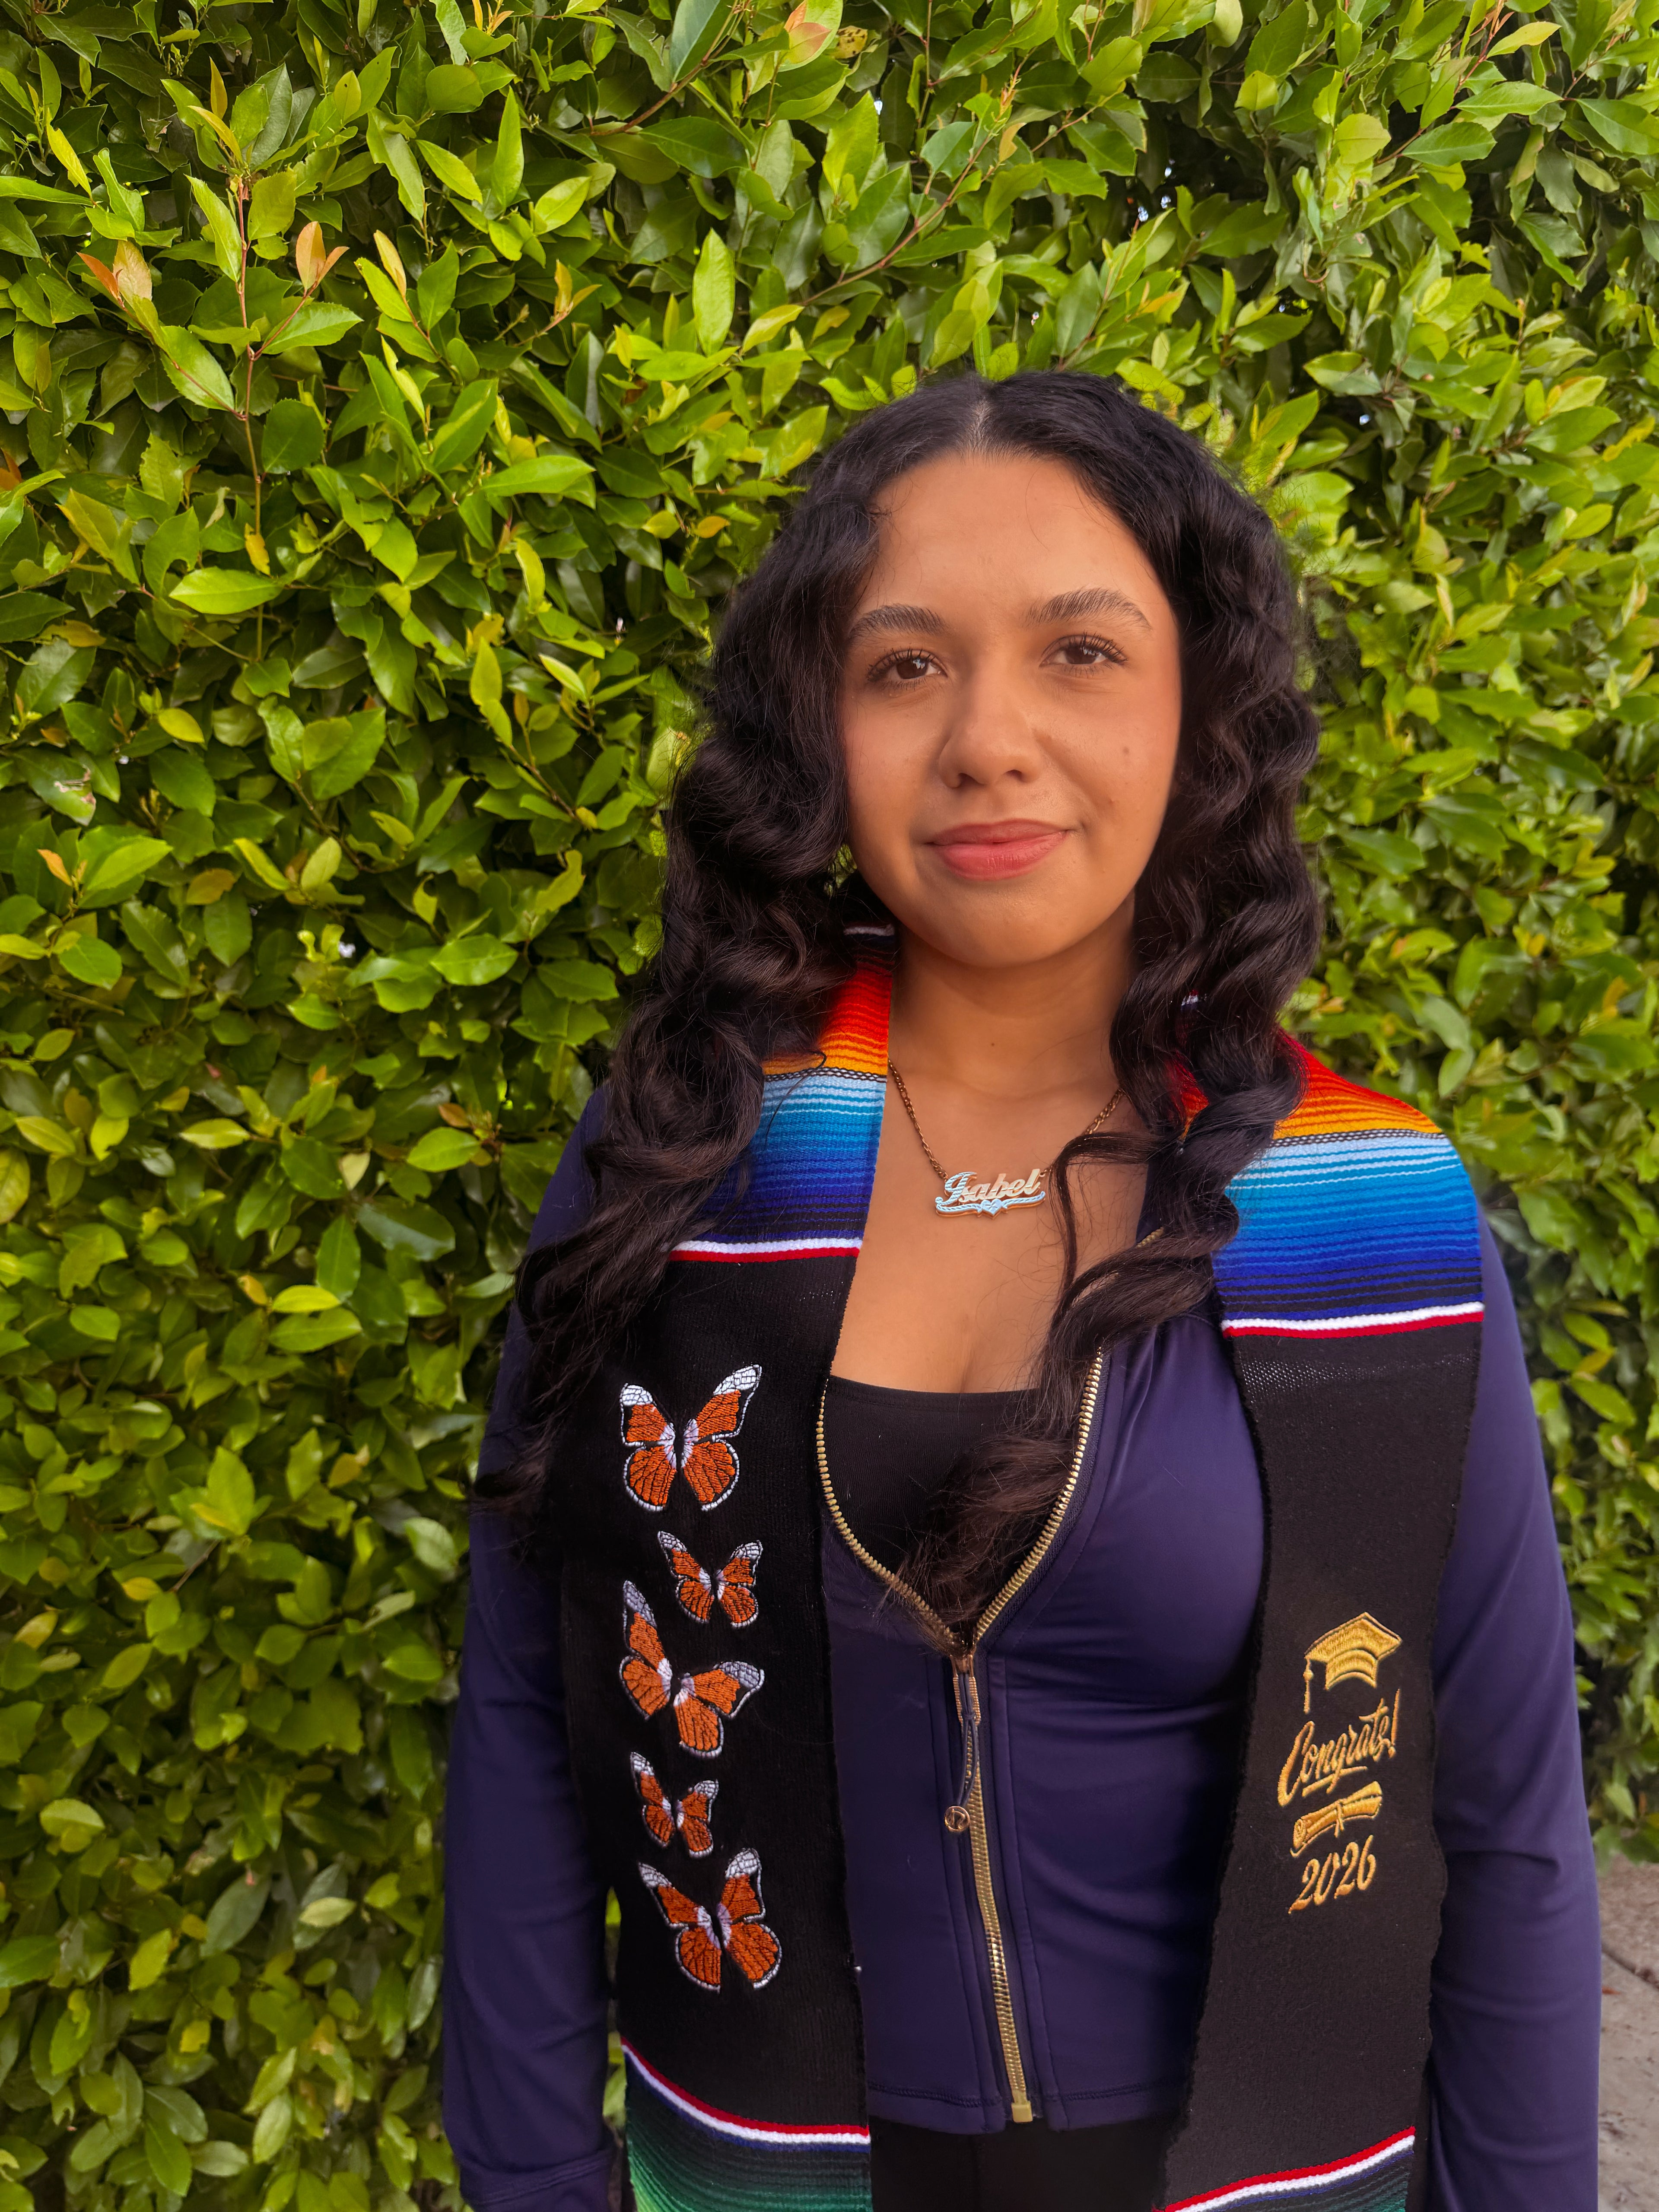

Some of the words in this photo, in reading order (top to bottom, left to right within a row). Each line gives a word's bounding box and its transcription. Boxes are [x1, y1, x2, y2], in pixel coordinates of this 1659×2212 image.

[935, 1168, 1041, 1206] Isabel
[1278, 1688, 1400, 1807] Congrats!
[1288, 1834, 1376, 1914] 2026
